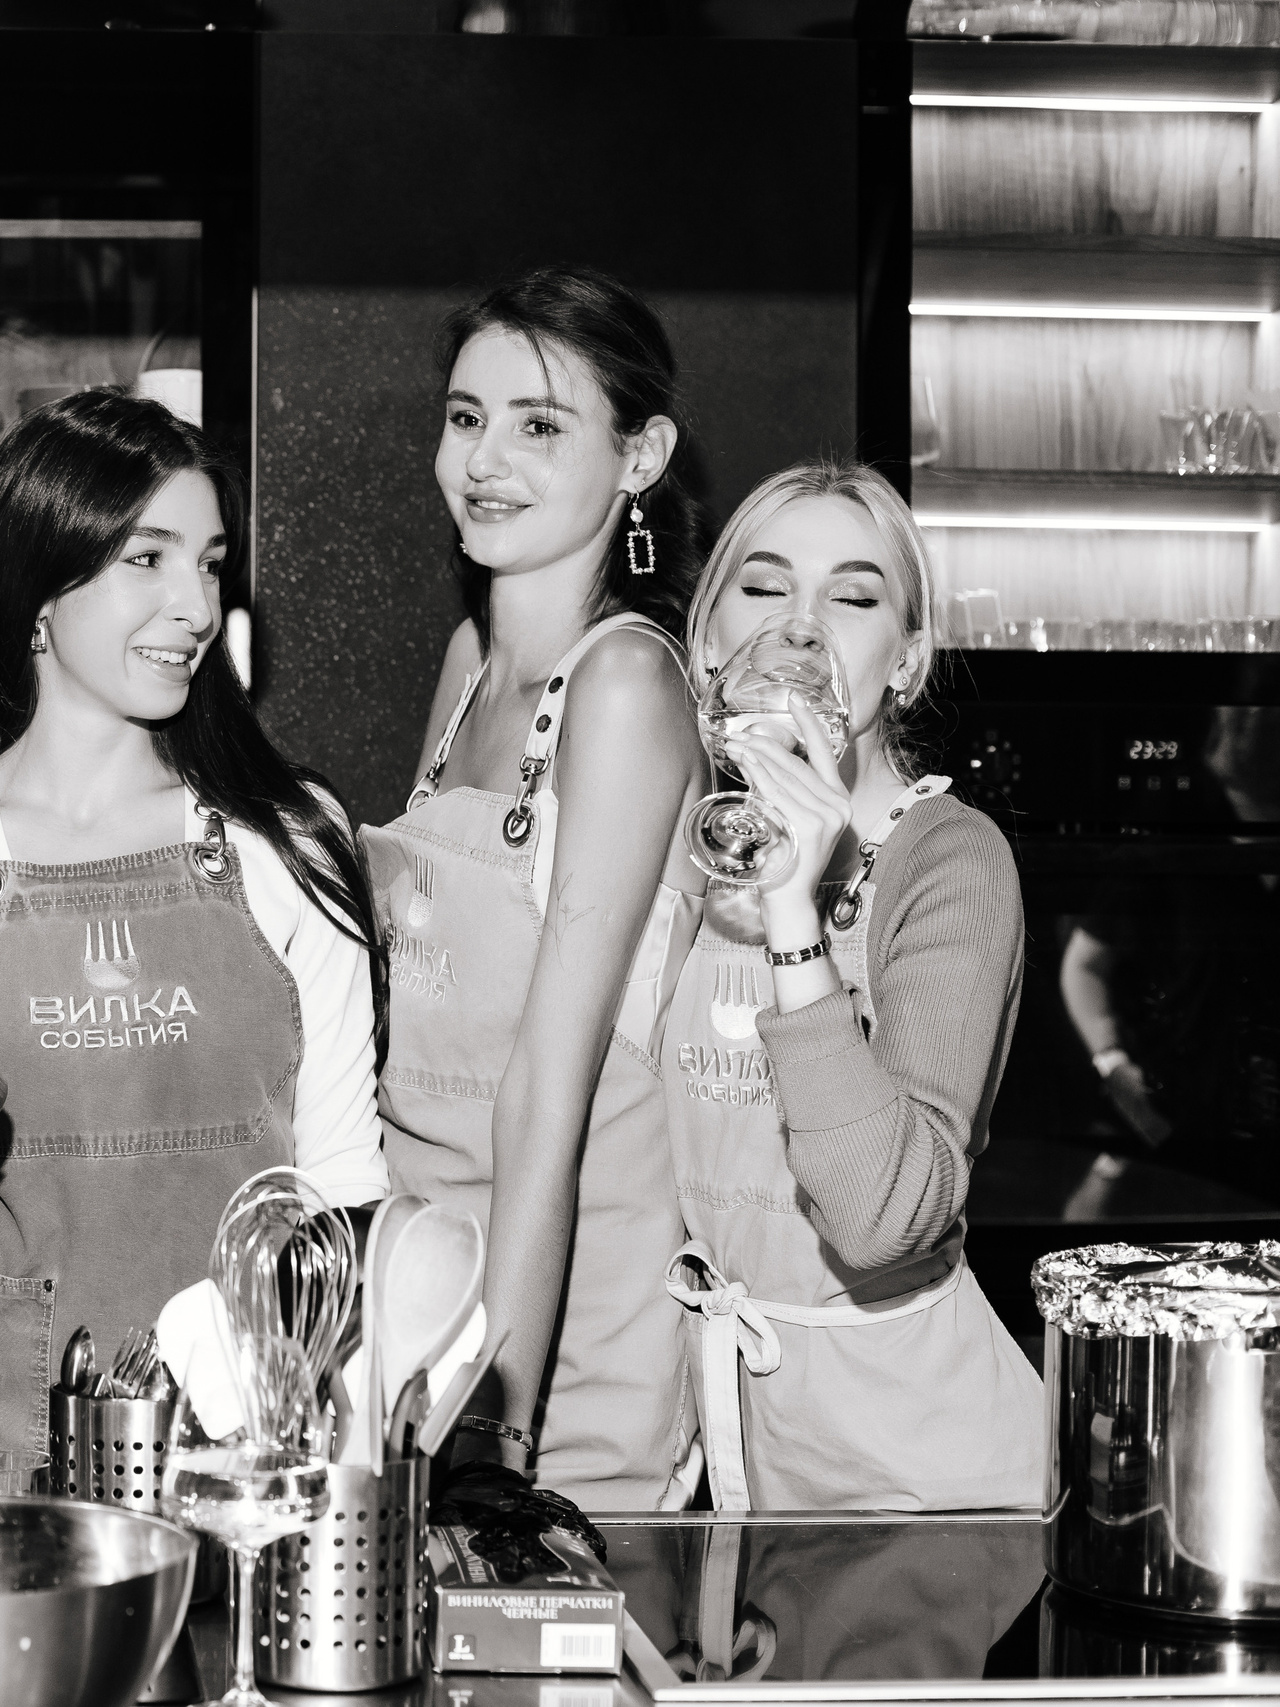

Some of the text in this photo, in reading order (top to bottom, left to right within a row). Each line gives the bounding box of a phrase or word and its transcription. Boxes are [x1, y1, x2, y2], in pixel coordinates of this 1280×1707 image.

[29, 986, 198, 1025] ВИЛКА
[40, 1022, 188, 1049] СОБЫТИЯ
[678, 1041, 771, 1080] ВИЛК
[686, 1079, 776, 1106] СОБЫТИЯ
[447, 1594, 613, 1609] ВИНИЛОВЫЕ ПЕРЧАТКИ
[502, 1607, 558, 1619] ЧЕРНЫЕ
[453, 1634, 470, 1653] L
